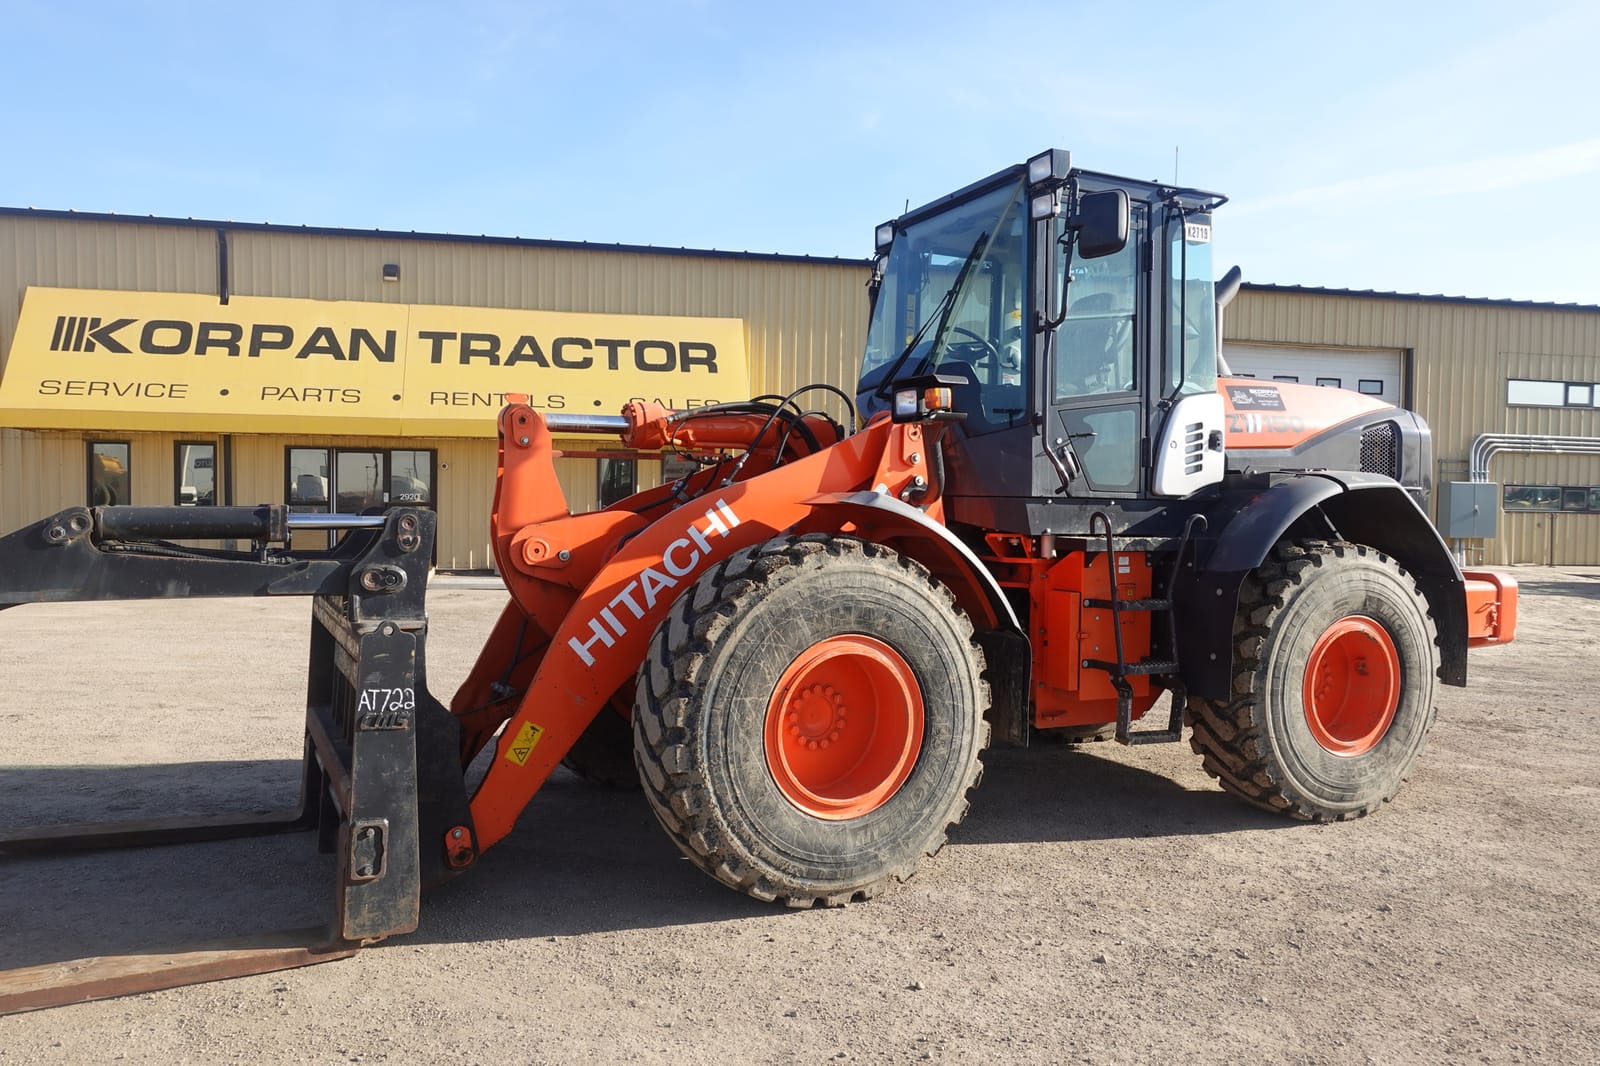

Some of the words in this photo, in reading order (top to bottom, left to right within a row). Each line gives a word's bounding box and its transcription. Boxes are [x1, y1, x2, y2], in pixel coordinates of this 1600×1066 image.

[50, 315, 397, 363] KORPAN
[418, 330, 719, 373] TRACTOR
[38, 380, 189, 399] SERVICE
[260, 386, 361, 403] PARTS
[430, 391, 566, 409] RENTLS
[567, 498, 741, 667] HITACHI
[357, 688, 415, 712] AT722
